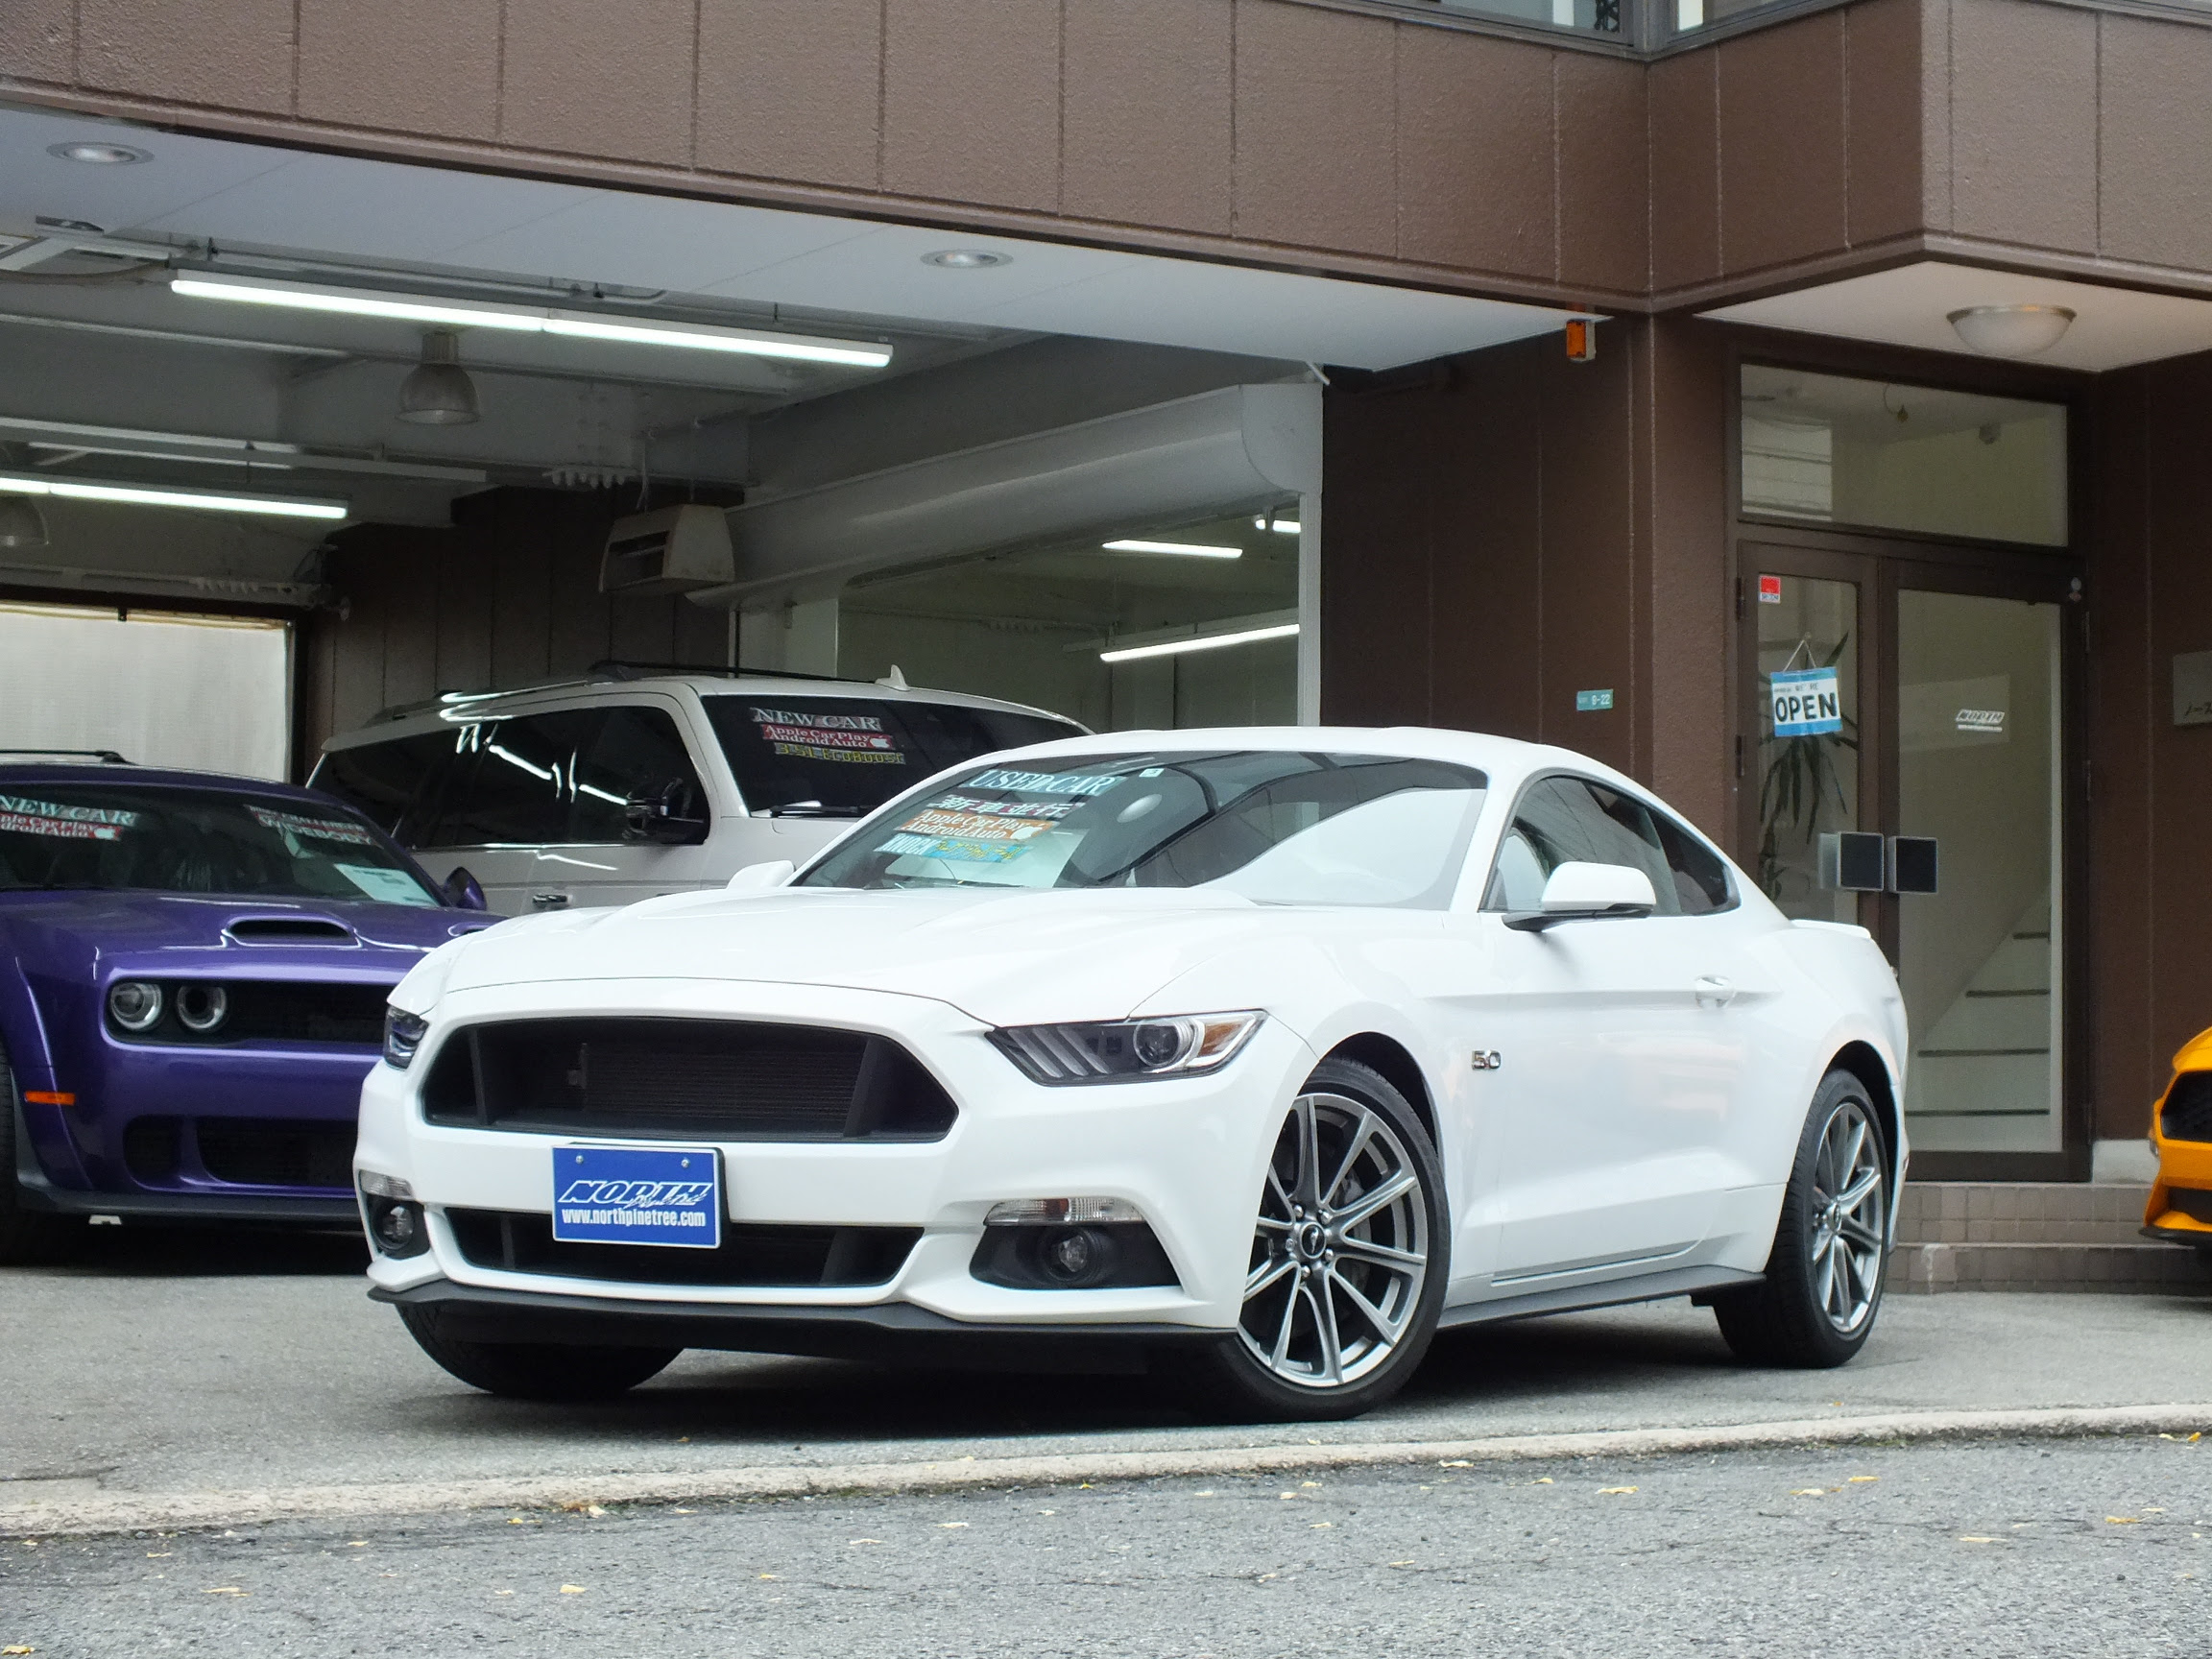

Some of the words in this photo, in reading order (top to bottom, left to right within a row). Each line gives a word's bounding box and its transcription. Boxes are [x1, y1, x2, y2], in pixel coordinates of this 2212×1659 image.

[1775, 692, 1838, 722] OPEN
[756, 709, 814, 726] NEW
[823, 715, 878, 731] CAR
[765, 725, 808, 736] Apple
[768, 731, 830, 746] Android
[831, 738, 868, 749] Auto
[969, 769, 1055, 792] USED
[1045, 775, 1118, 795] CAR
[0, 795, 62, 816] NEW
[69, 807, 132, 825] CAR
[914, 809, 966, 825] Apple
[901, 820, 974, 837] Android
[964, 827, 1008, 839] Auto
[562, 1208, 706, 1226] www.northpinetree.com
